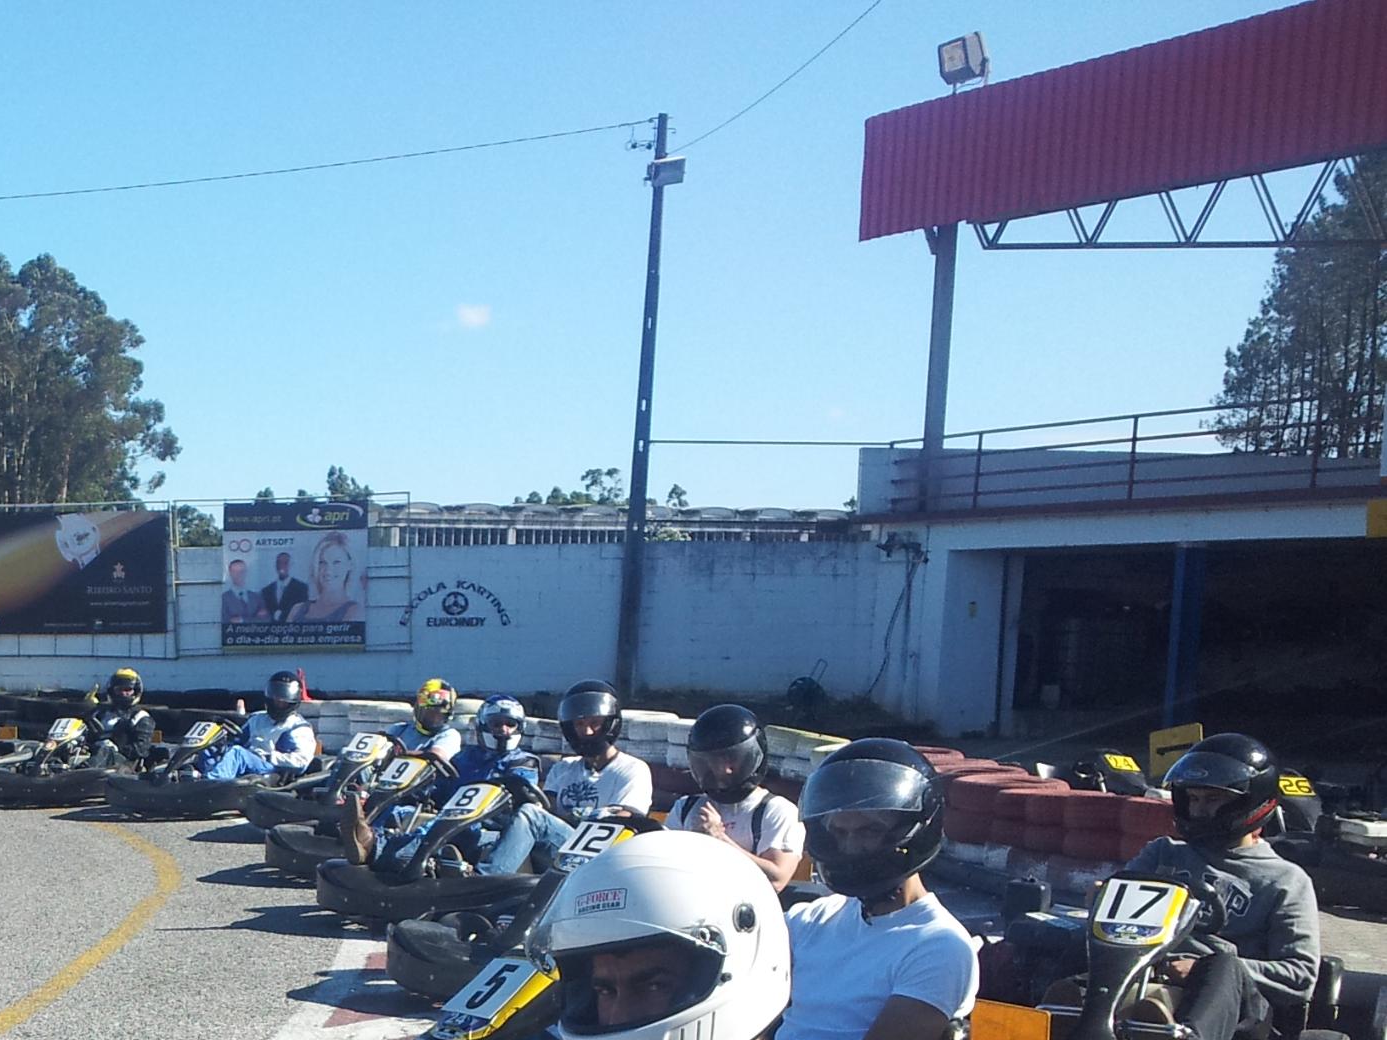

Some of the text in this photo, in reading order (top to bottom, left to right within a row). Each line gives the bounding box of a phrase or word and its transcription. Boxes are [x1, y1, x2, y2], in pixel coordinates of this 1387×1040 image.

[324, 509, 350, 524] apri
[255, 538, 294, 546] ARTSOFT
[456, 580, 511, 626] KARTING
[325, 623, 350, 633] gerir
[426, 617, 486, 627] EUROINDY
[281, 635, 294, 644] da
[318, 635, 362, 645] empresa
[53, 718, 71, 733] 14
[190, 722, 211, 736] 16
[356, 735, 373, 750] 6
[391, 761, 410, 780] 9
[1282, 778, 1311, 793] 26
[455, 787, 481, 807] 8
[568, 823, 616, 853] 12
[1106, 883, 1169, 920] 17
[465, 963, 520, 1010] 5
